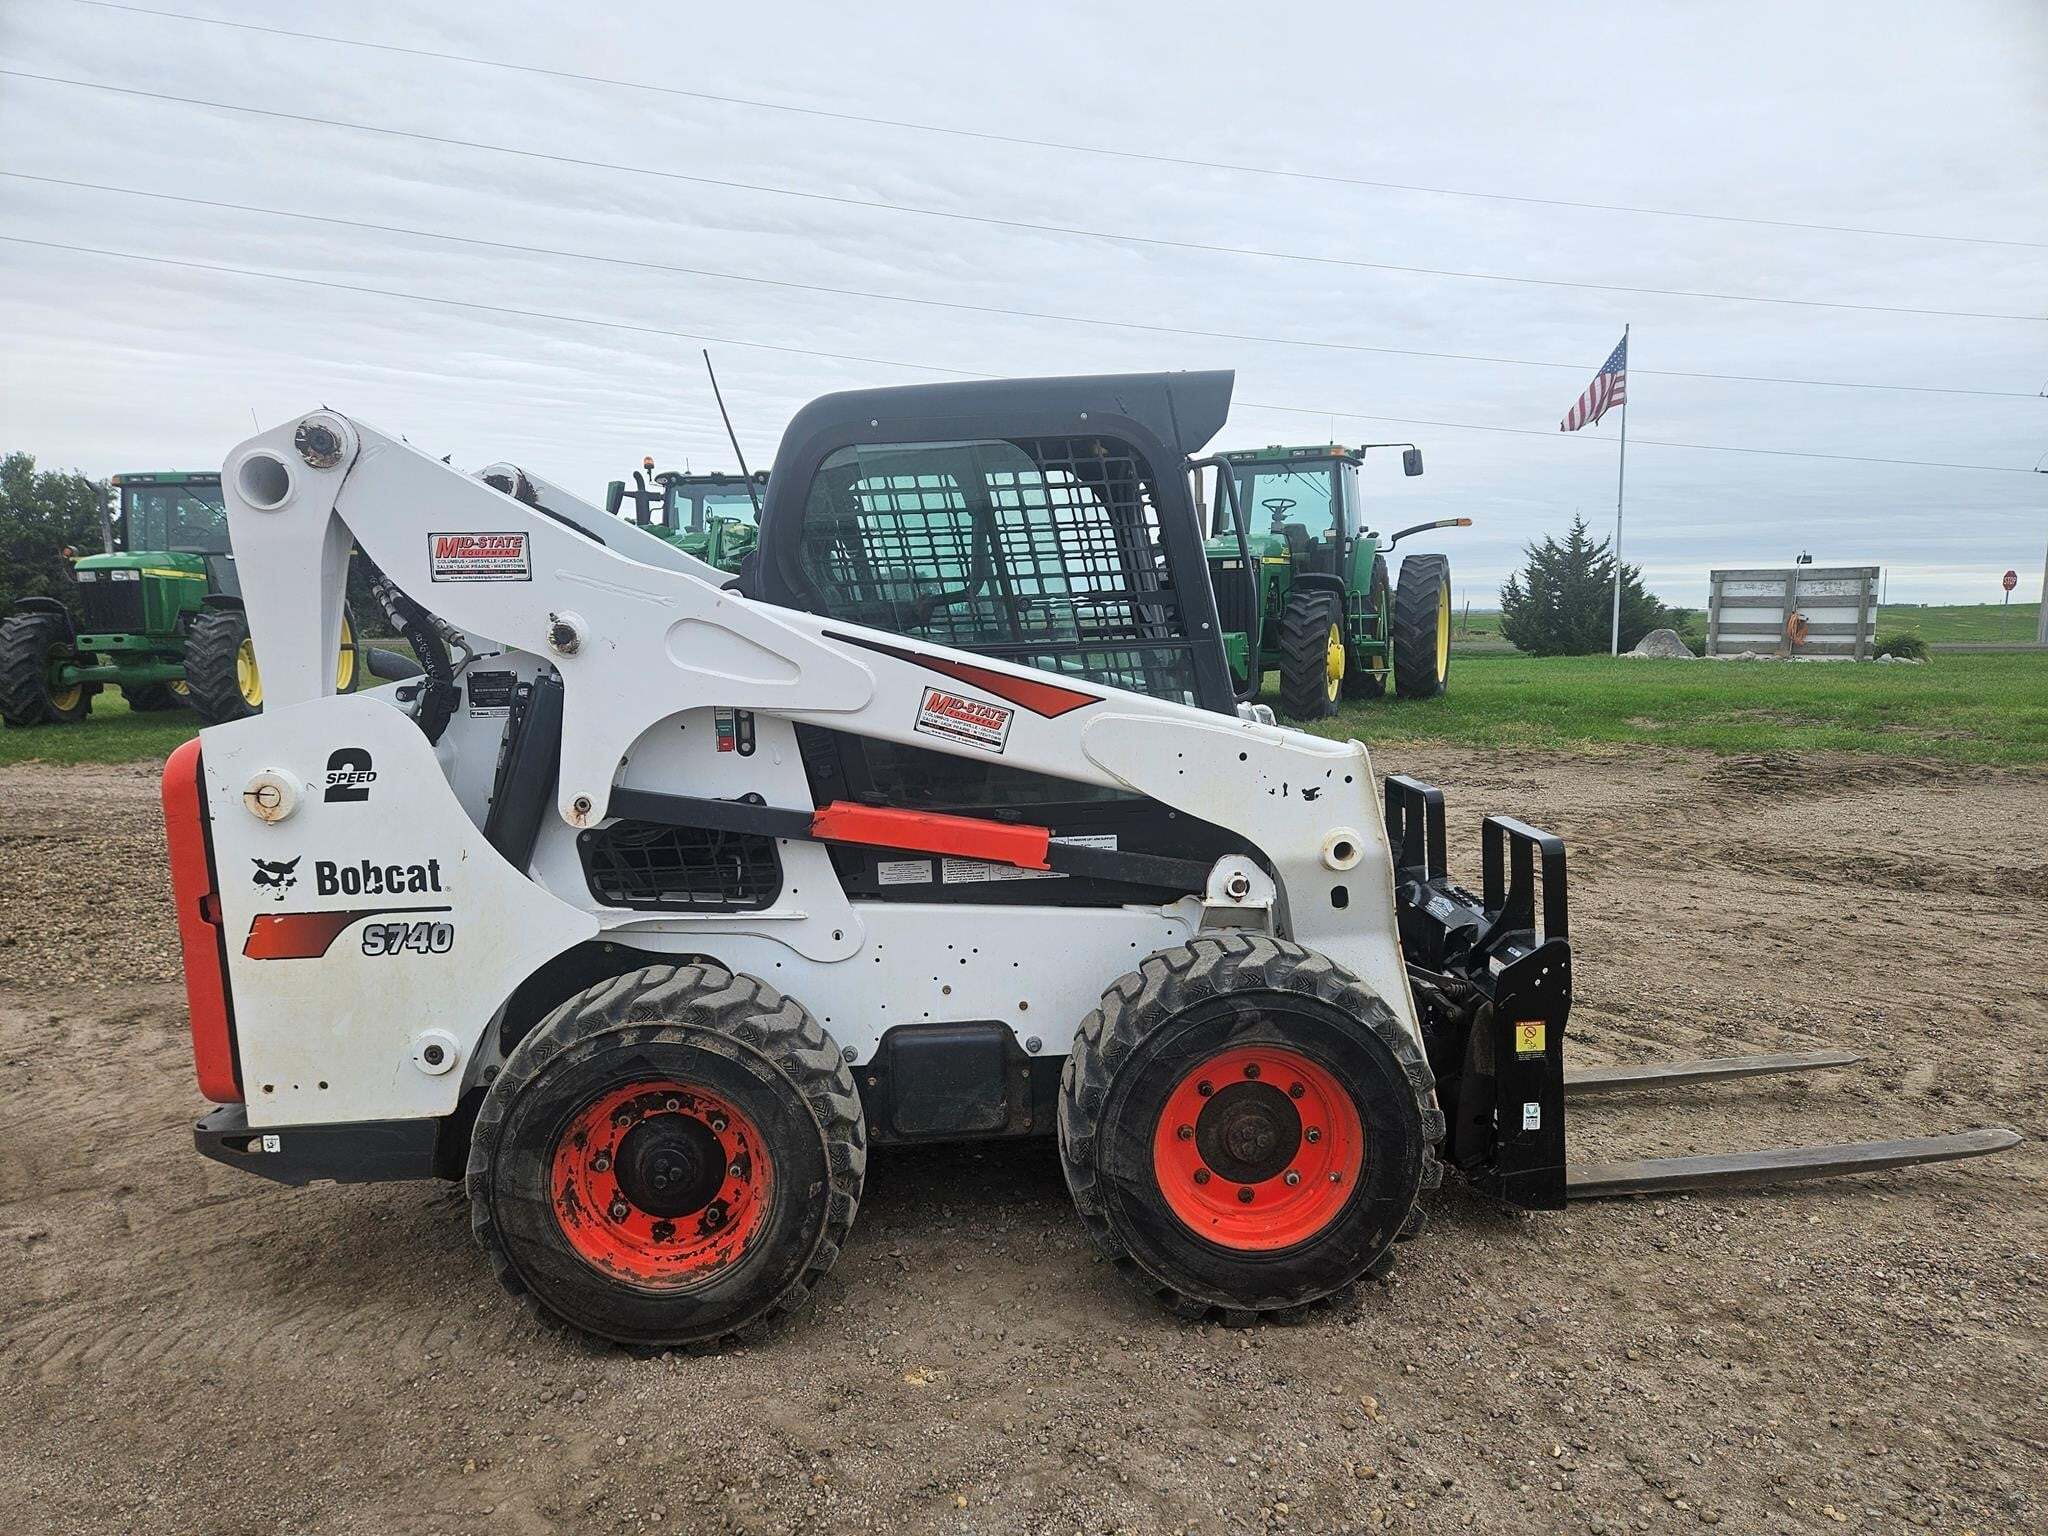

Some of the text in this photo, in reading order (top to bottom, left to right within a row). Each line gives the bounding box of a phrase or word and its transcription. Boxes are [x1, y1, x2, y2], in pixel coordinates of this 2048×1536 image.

[436, 536, 523, 558] MID-STATE
[462, 549, 517, 557] EQUIPMENT
[2004, 576, 2016, 585] STOP
[925, 692, 1009, 722] MID-STATE
[948, 710, 1001, 727] EQUIPMENT
[324, 747, 373, 803] 2
[325, 771, 377, 785] SPEED
[315, 858, 442, 896] Bobcat
[361, 921, 454, 957] S740
